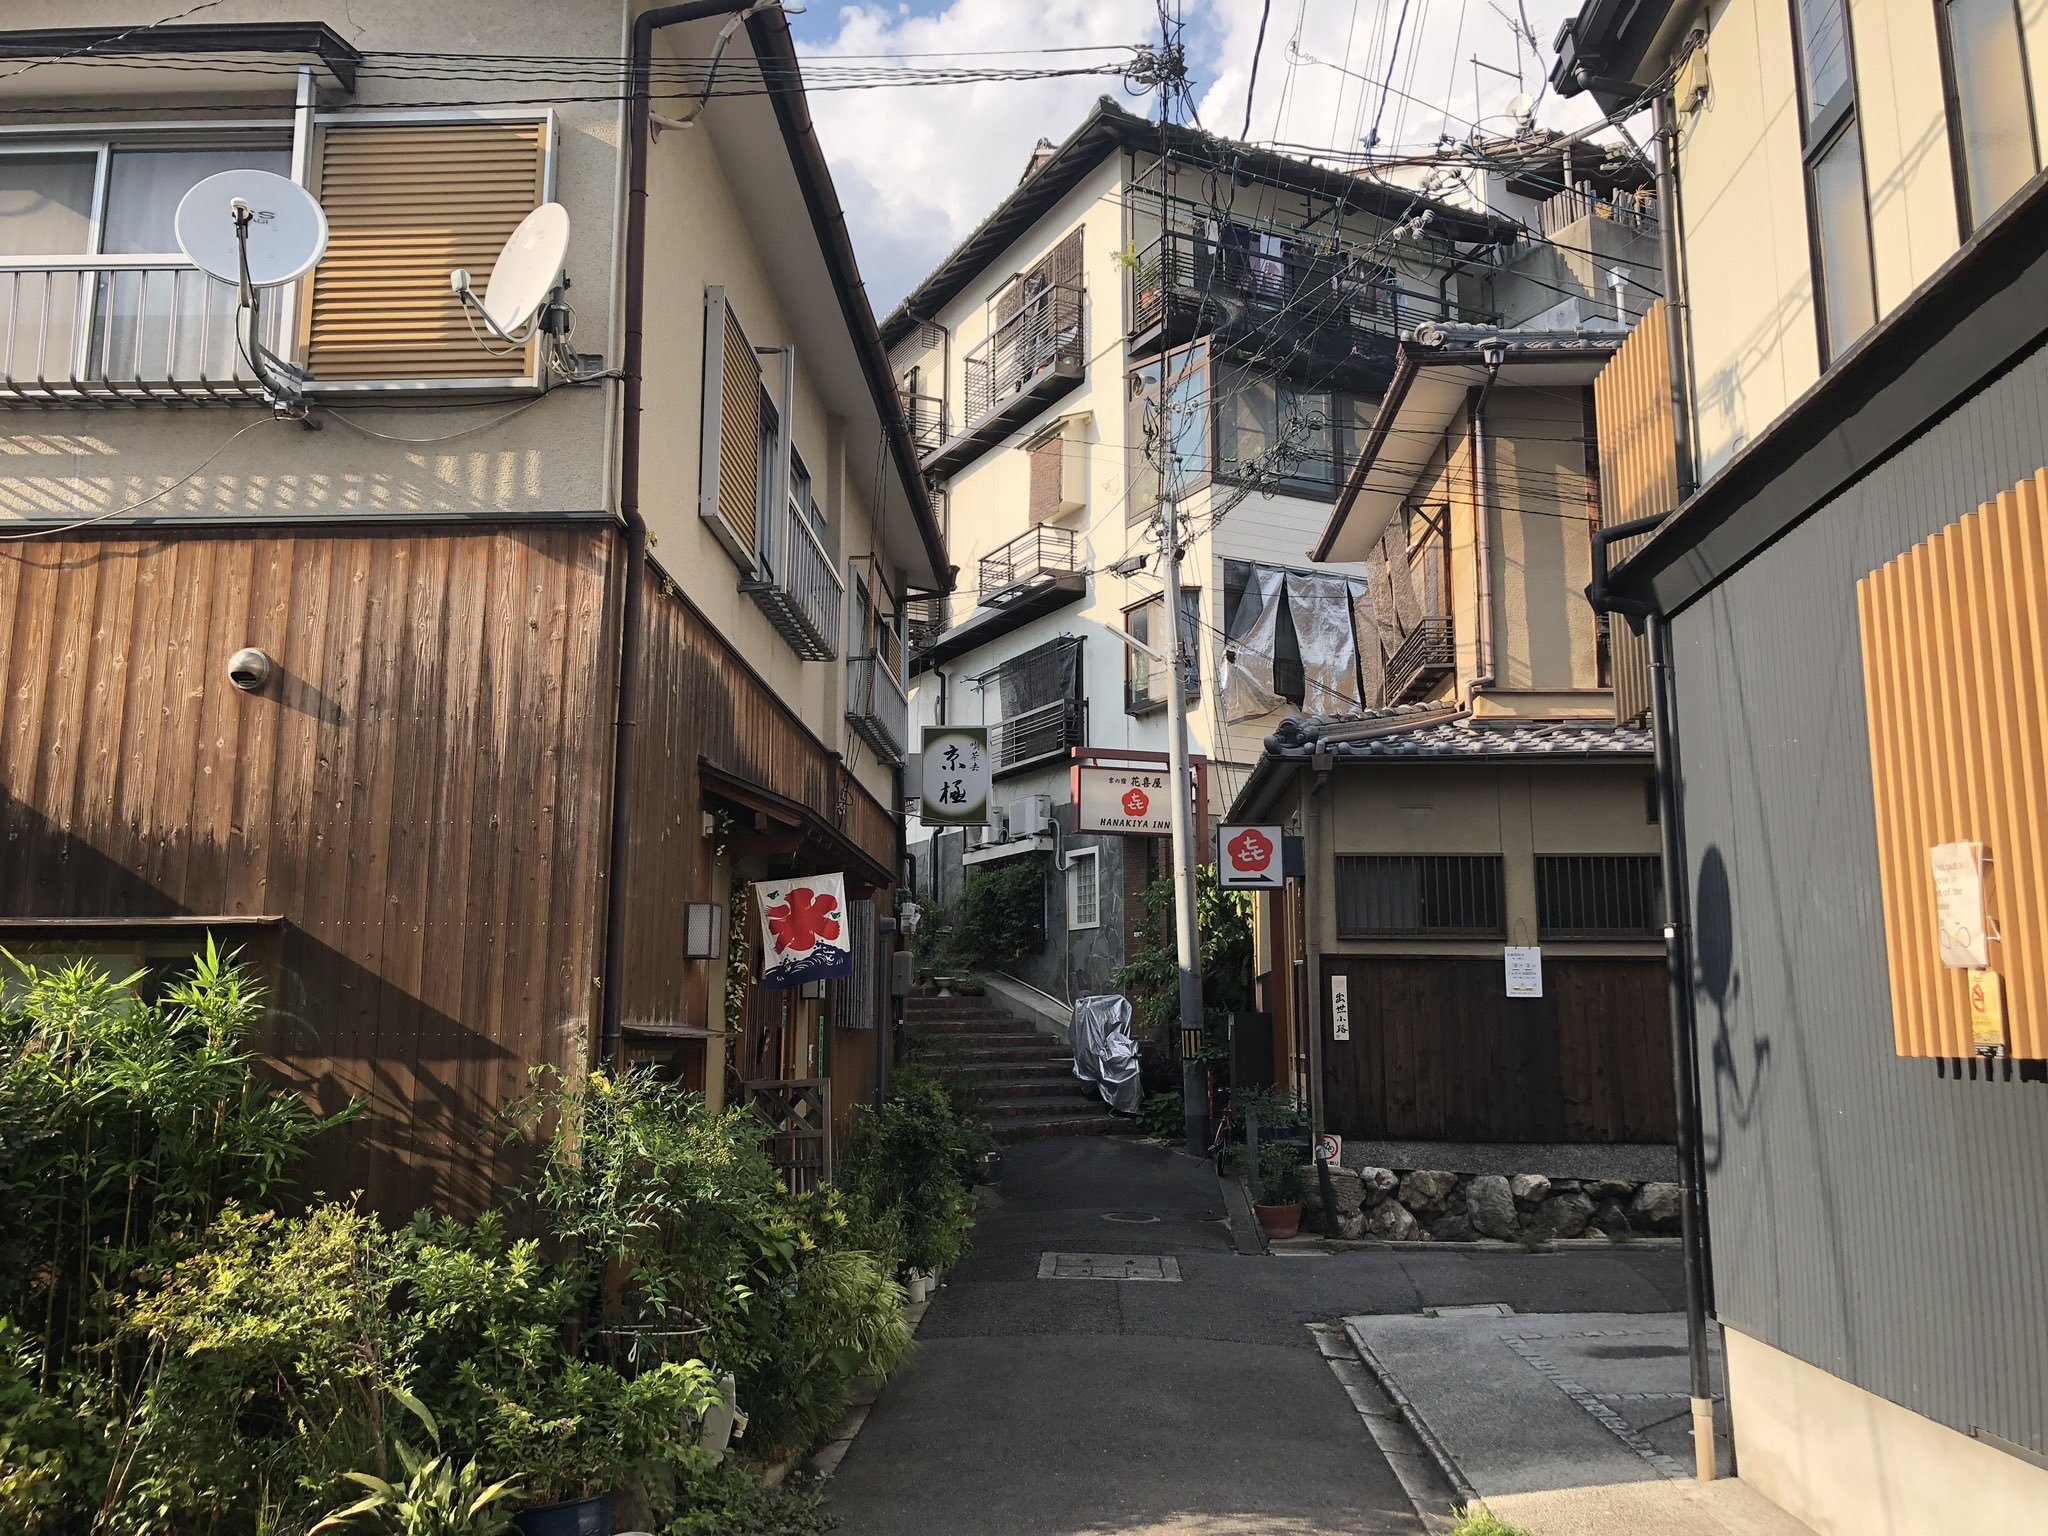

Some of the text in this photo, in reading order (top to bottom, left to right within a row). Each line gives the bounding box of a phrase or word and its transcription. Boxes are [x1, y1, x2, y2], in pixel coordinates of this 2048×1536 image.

[938, 744, 967, 805] 京極
[1130, 776, 1162, 789] 花喜屋
[1100, 818, 1171, 829] HANAKIYA INN
[1335, 992, 1348, 1034] 出世小路
